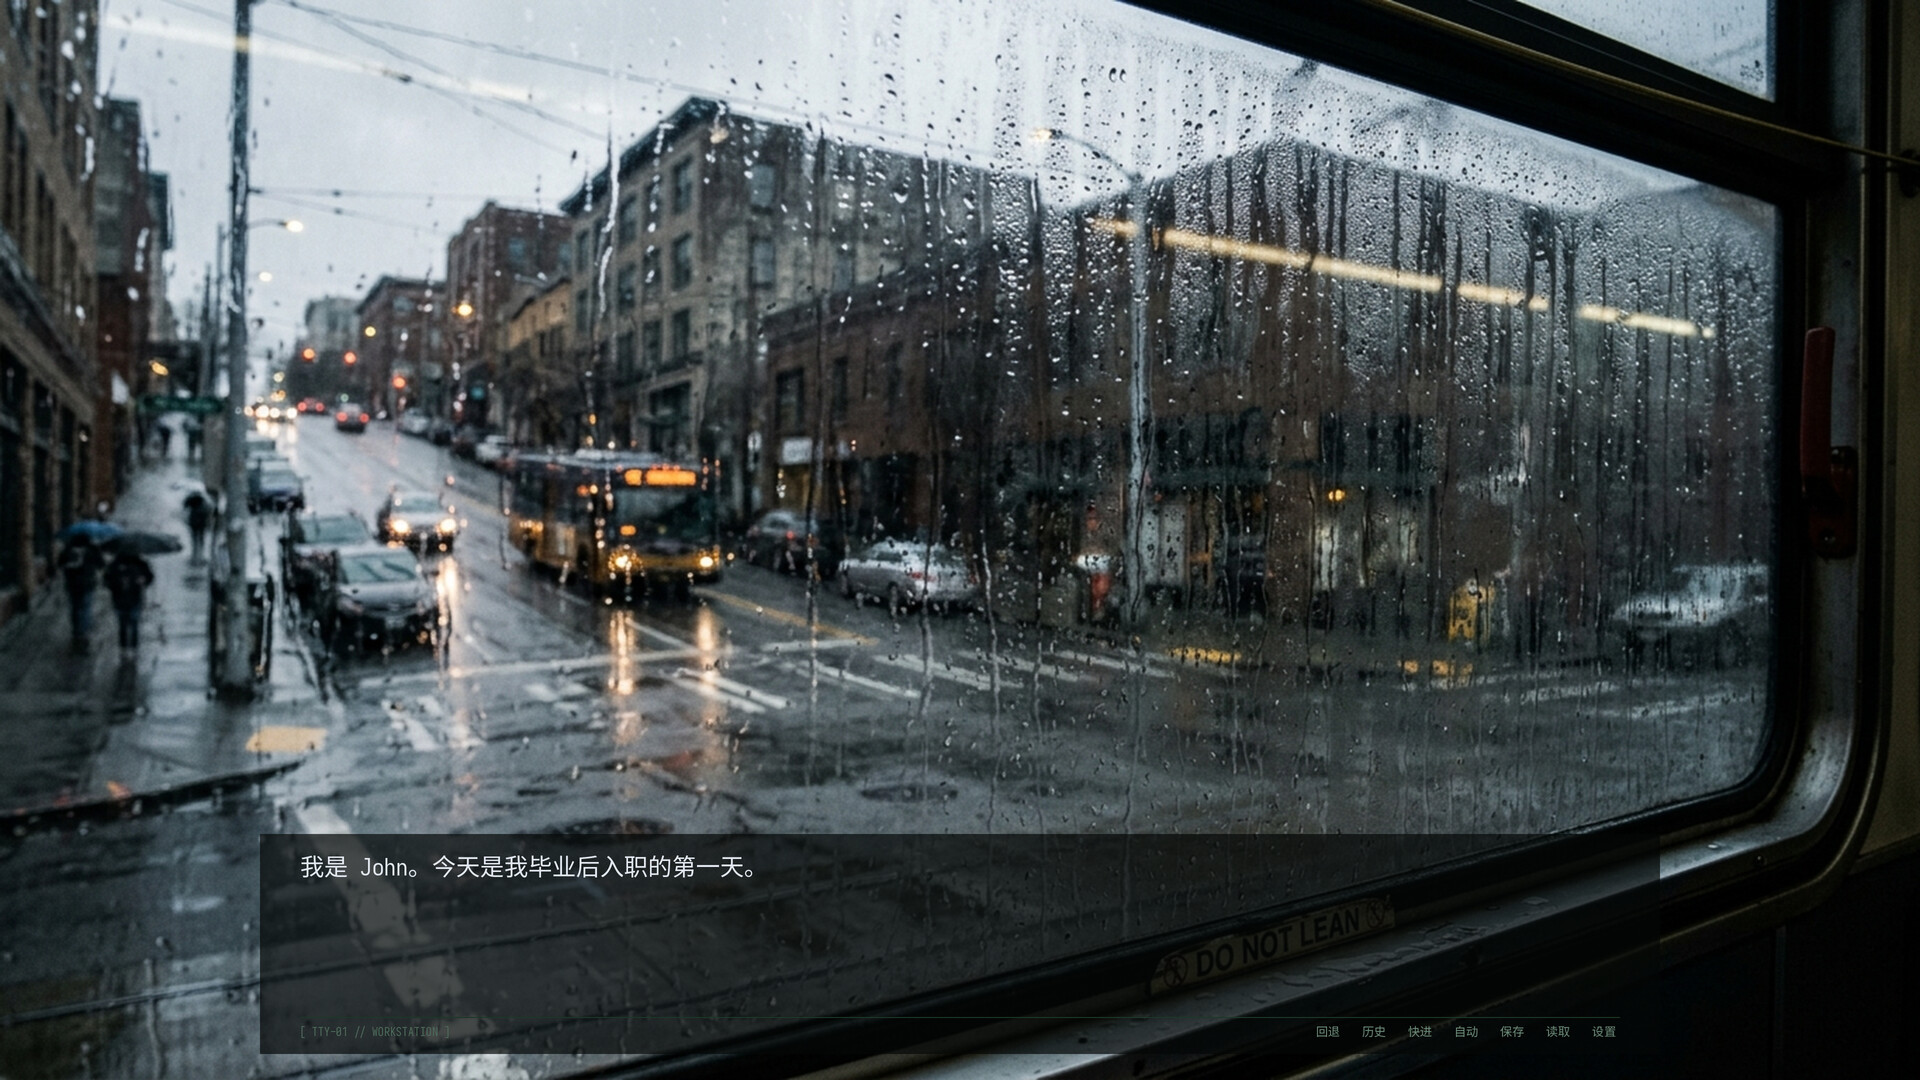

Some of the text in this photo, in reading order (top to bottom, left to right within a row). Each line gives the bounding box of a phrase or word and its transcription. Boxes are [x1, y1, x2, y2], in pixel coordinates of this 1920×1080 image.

[1195, 907, 1360, 977] DO NOT LEAN
